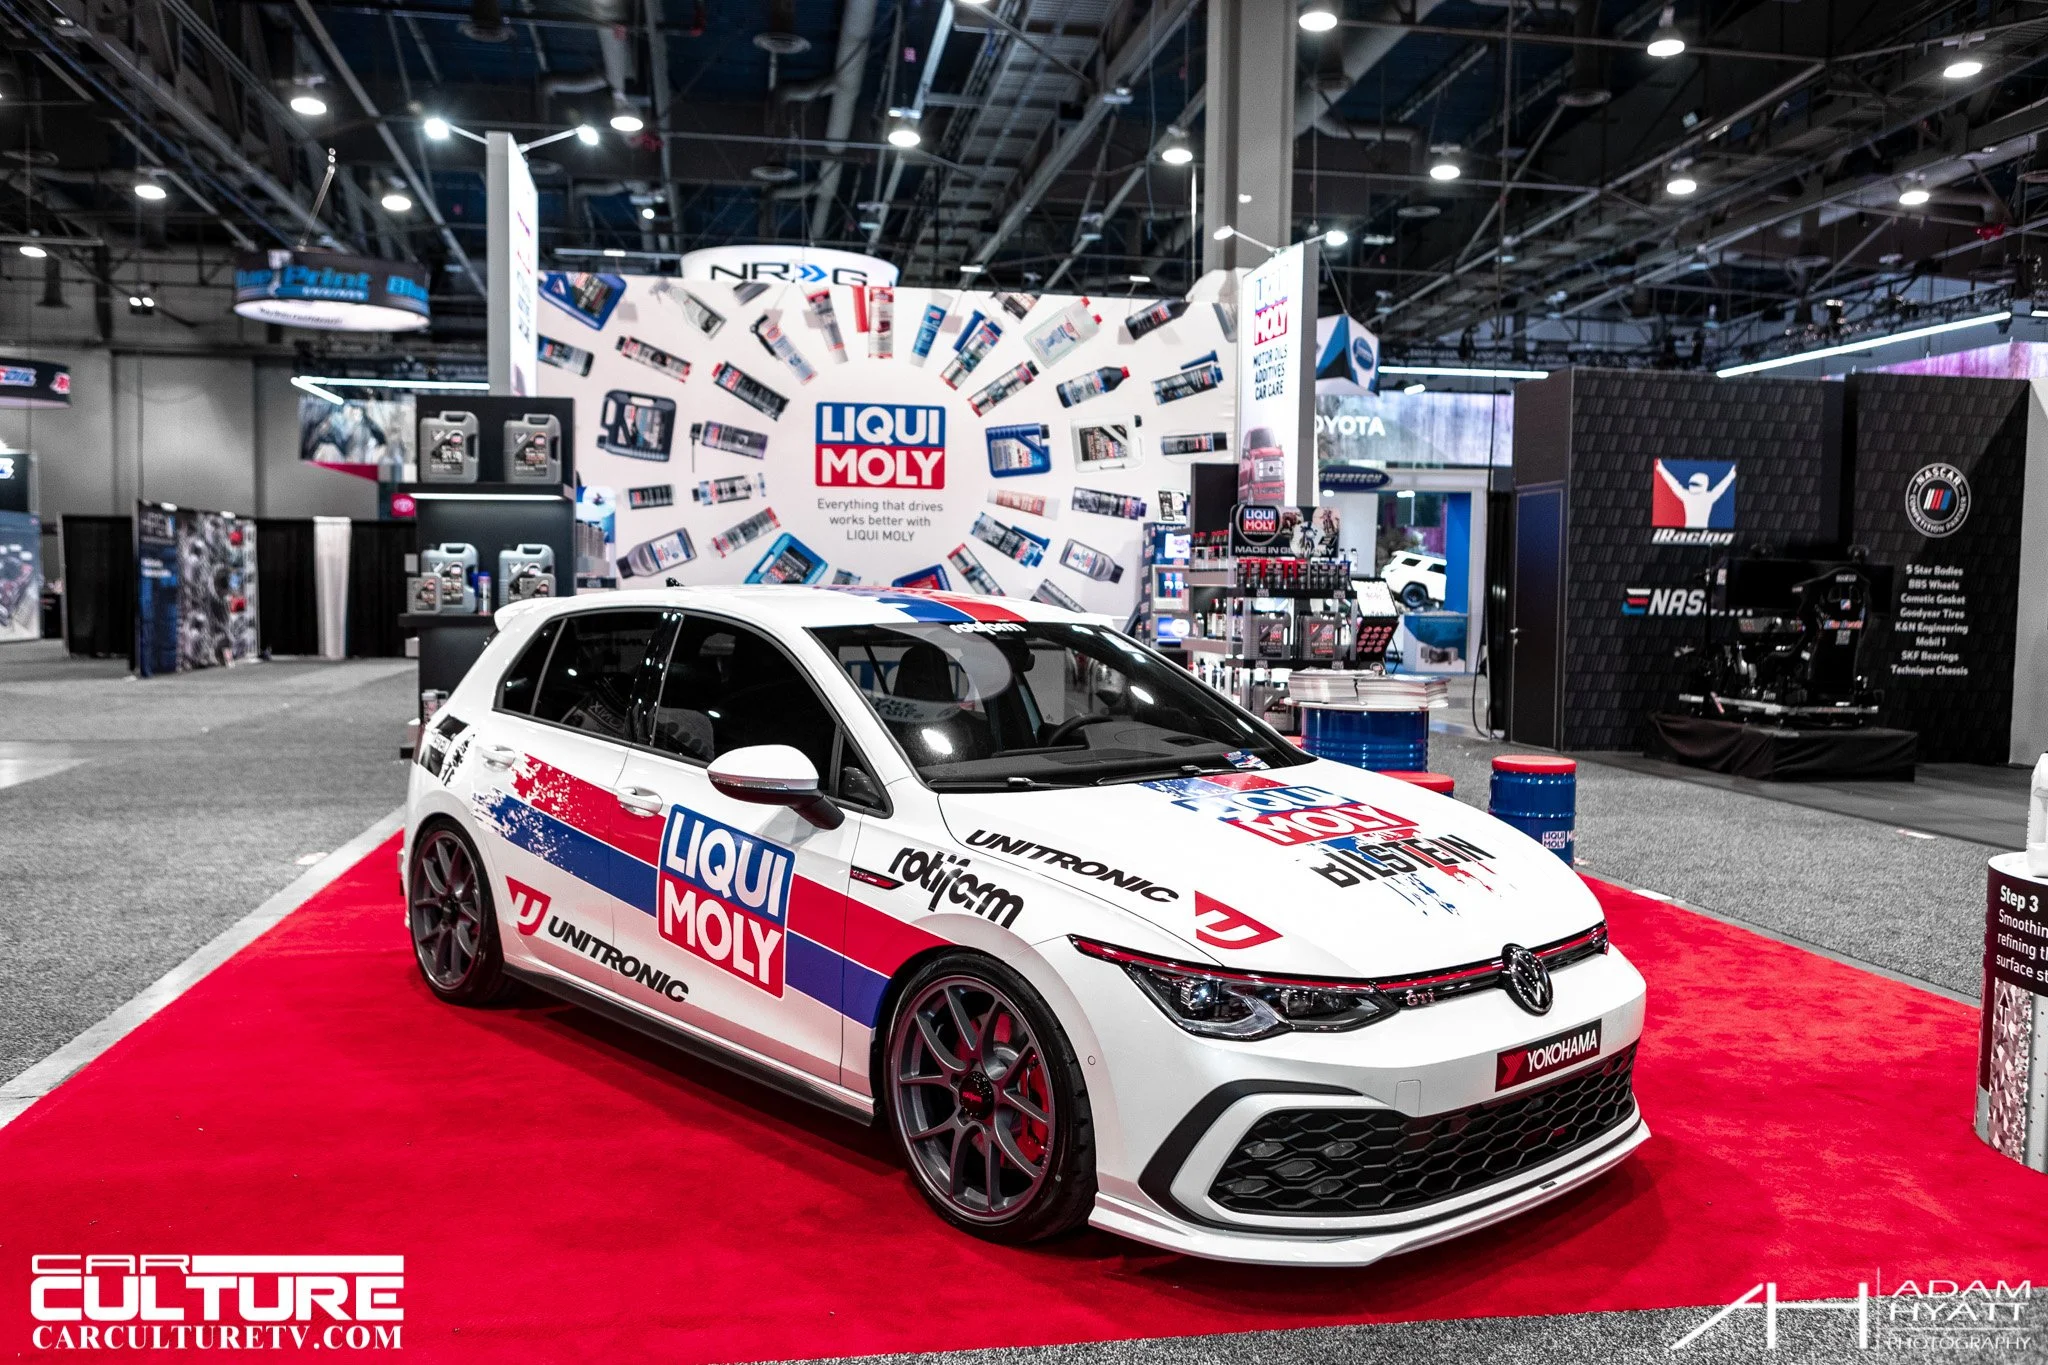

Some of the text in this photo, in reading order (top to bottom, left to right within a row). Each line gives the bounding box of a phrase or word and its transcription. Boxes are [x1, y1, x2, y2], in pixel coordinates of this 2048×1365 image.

[1253, 349, 1273, 366] MOTOR
[1255, 362, 1285, 385] ADDITIVES
[1255, 380, 1284, 400] CAR CARE
[822, 405, 940, 445] LIQUI
[821, 448, 943, 486] MOLY
[1915, 467, 1961, 487] NASCAR
[817, 498, 944, 512] Everything that drives
[829, 515, 931, 527] works better with
[1245, 510, 1274, 520] LIQUI
[1245, 520, 1275, 530] MOLY
[846, 530, 915, 542] LIQUI MOLY
[1652, 528, 1735, 546] iRacing
[1905, 564, 1964, 576] 5 Star Bodies
[1908, 578, 1960, 590] BBS Wheels
[1936, 594, 1966, 605] Gasket
[1900, 607, 1965, 619] Goodyear Tires
[1895, 621, 1969, 635] K&N Engineering
[1916, 636, 1940, 647] Mobil
[1901, 650, 1959, 663] SKF Bearings
[1890, 664, 1969, 677] Technique Chassis
[1251, 804, 1402, 843] MOLY
[1543, 831, 1565, 839] LIQUI
[1543, 840, 1565, 848] MOLY
[666, 812, 787, 917] LIQUI
[965, 829, 1179, 902] UNITRONIC
[1310, 834, 1496, 888] BILSTEIN
[888, 847, 1024, 929] rotiform
[2000, 884, 2039, 913] Step 3
[664, 879, 783, 985] MOLY
[1997, 932, 2036, 960] refining
[548, 915, 689, 1003] UNITRONIC
[1996, 954, 2034, 978] surface
[1527, 1029, 1598, 1073] YOKOHAMA
